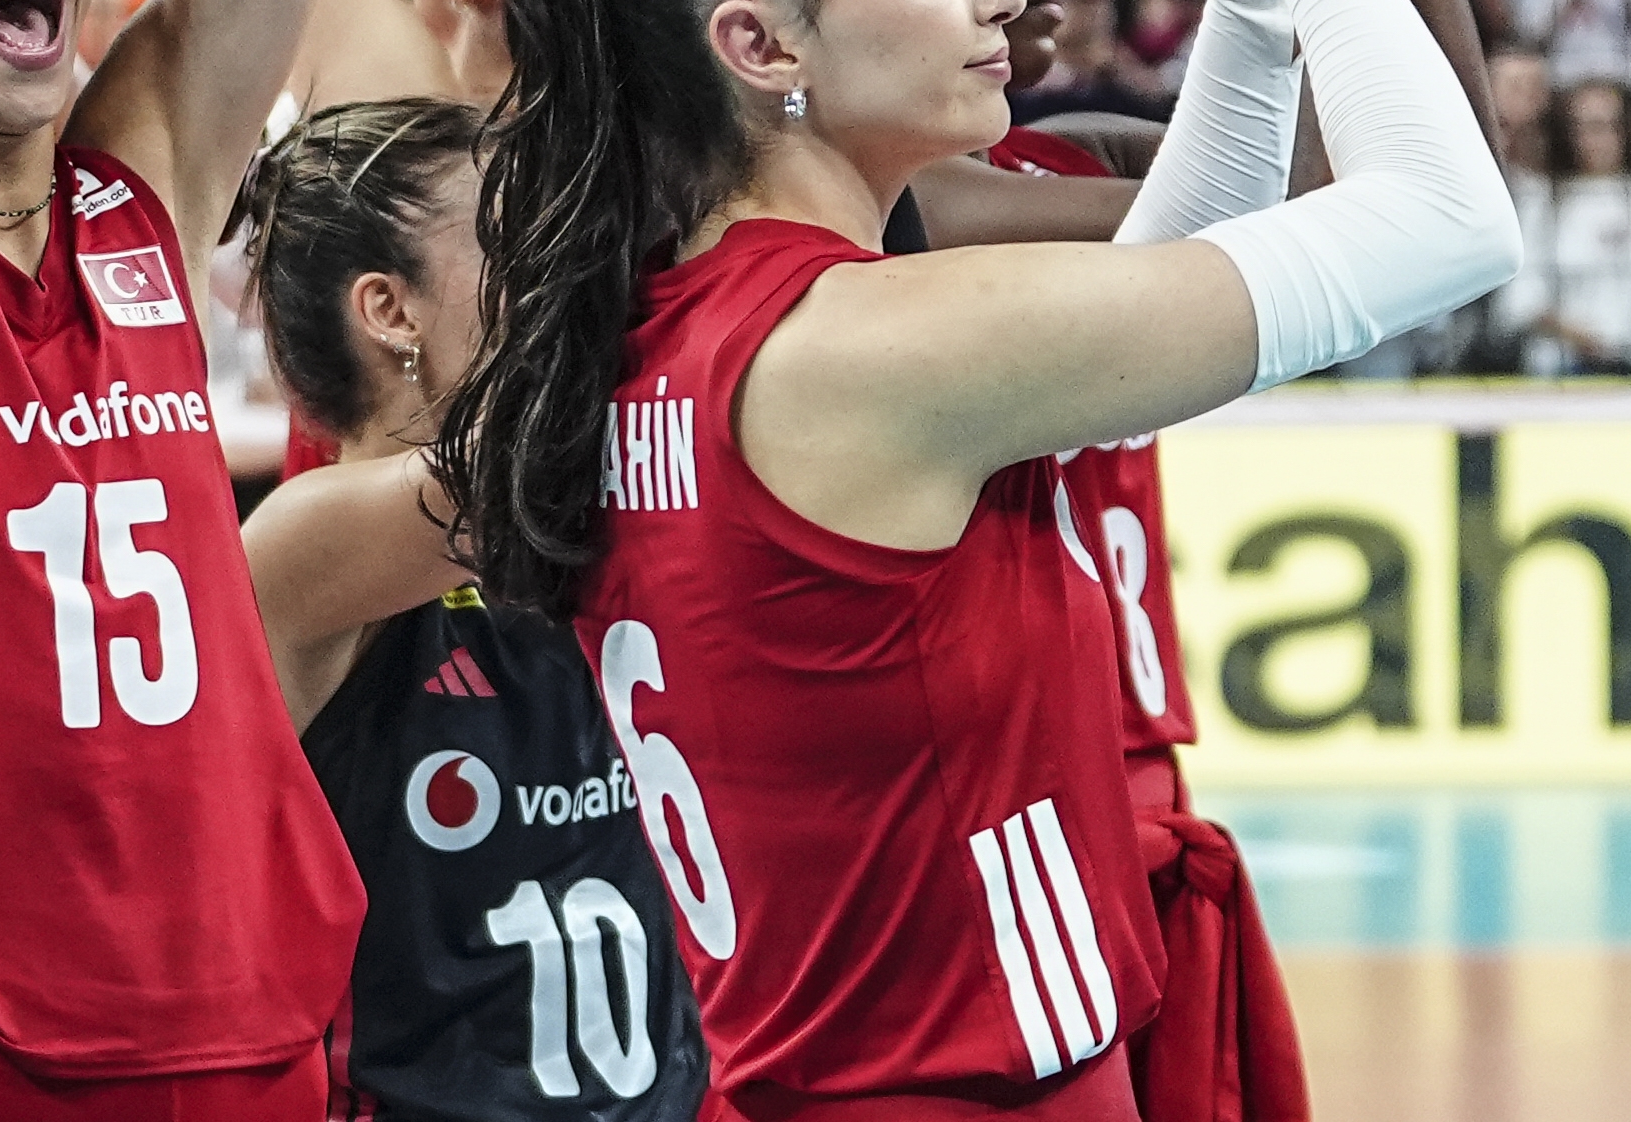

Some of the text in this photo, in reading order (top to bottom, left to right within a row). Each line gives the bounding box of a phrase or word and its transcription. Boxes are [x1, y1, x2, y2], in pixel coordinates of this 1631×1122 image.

[120, 305, 165, 322] TUR
[597, 375, 699, 511] AHİN
[6, 478, 199, 729] 15
[600, 619, 737, 961] 6
[486, 878, 657, 1099] 10
